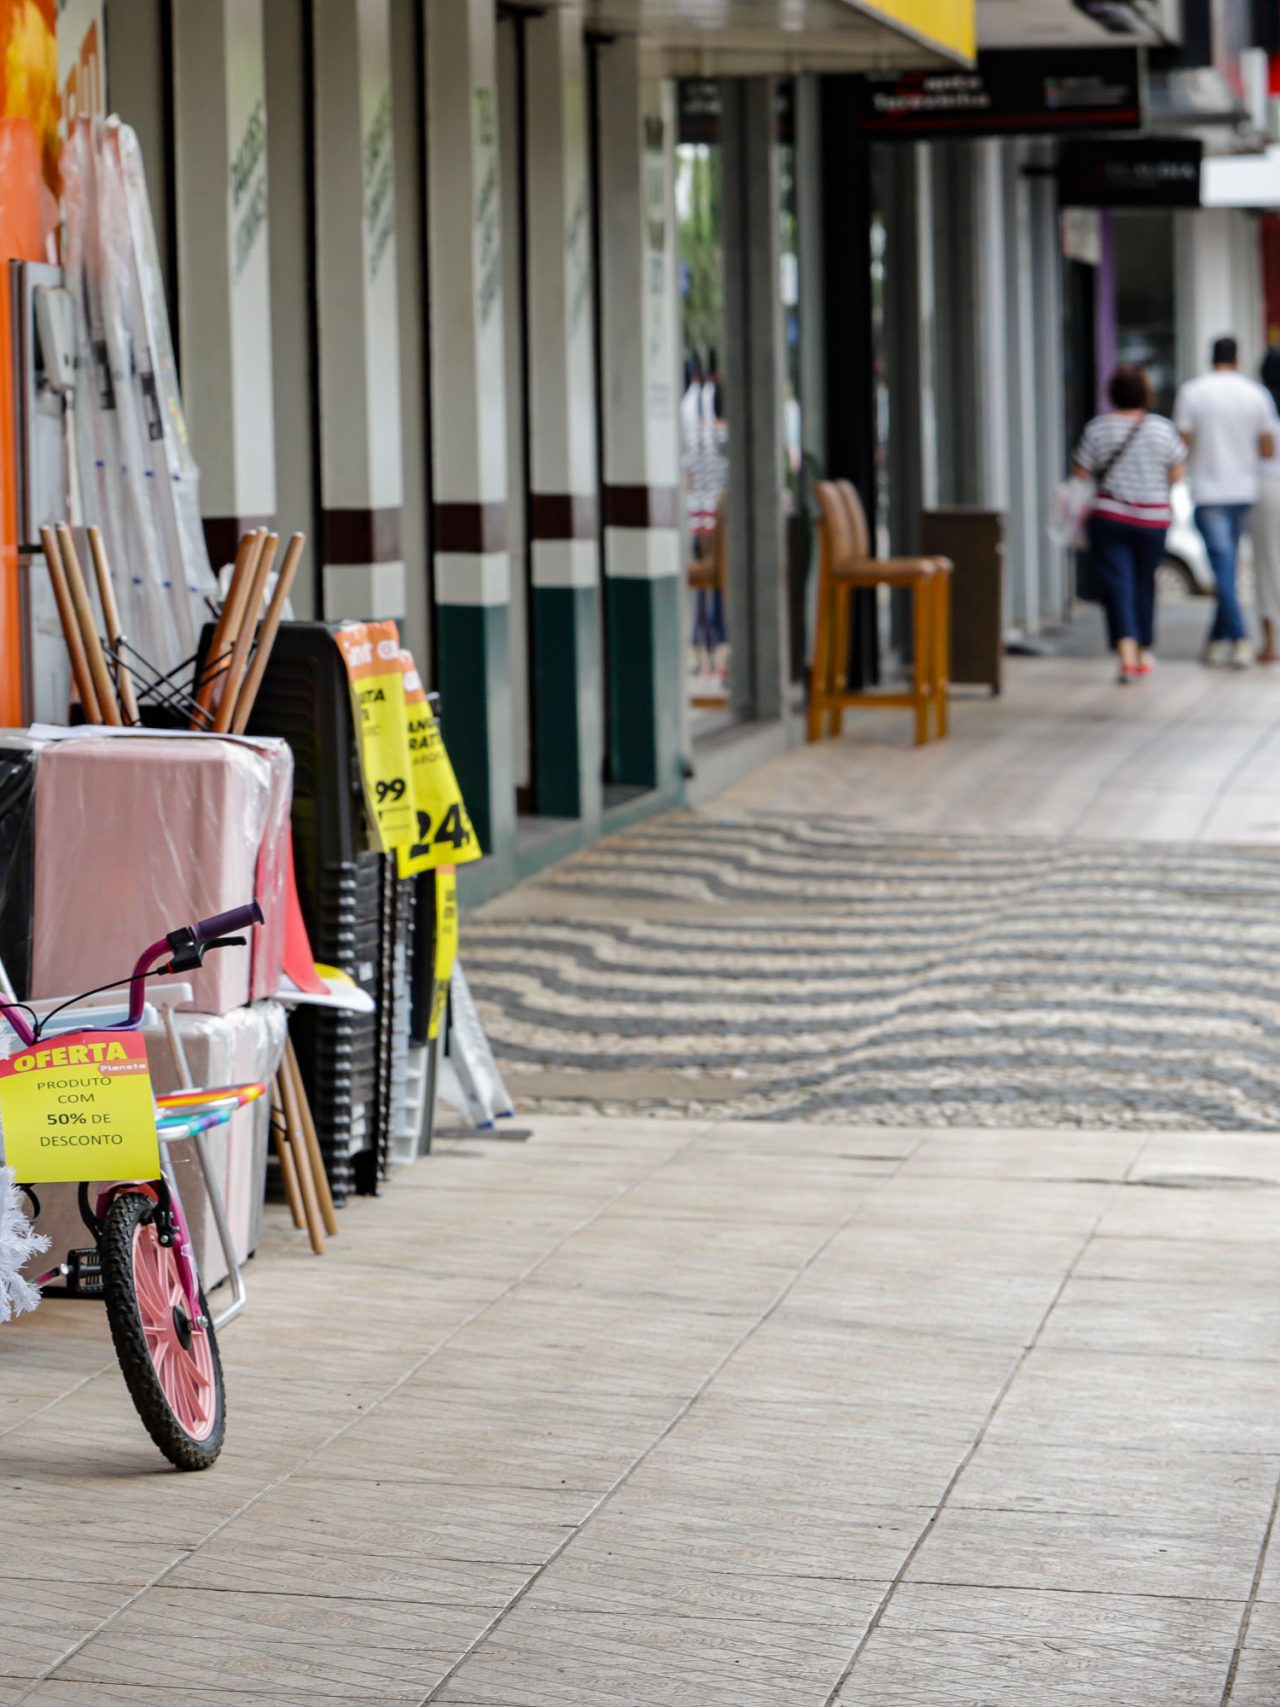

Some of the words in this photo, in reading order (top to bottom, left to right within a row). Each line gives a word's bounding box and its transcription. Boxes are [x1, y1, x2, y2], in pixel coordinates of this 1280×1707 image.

[13, 1041, 128, 1072] OFERTA
[37, 1076, 112, 1090] PRODUTO
[57, 1093, 95, 1104] COM
[47, 1112, 87, 1126] 50%
[91, 1113, 112, 1124] DE
[40, 1133, 123, 1147] DESCONTO
